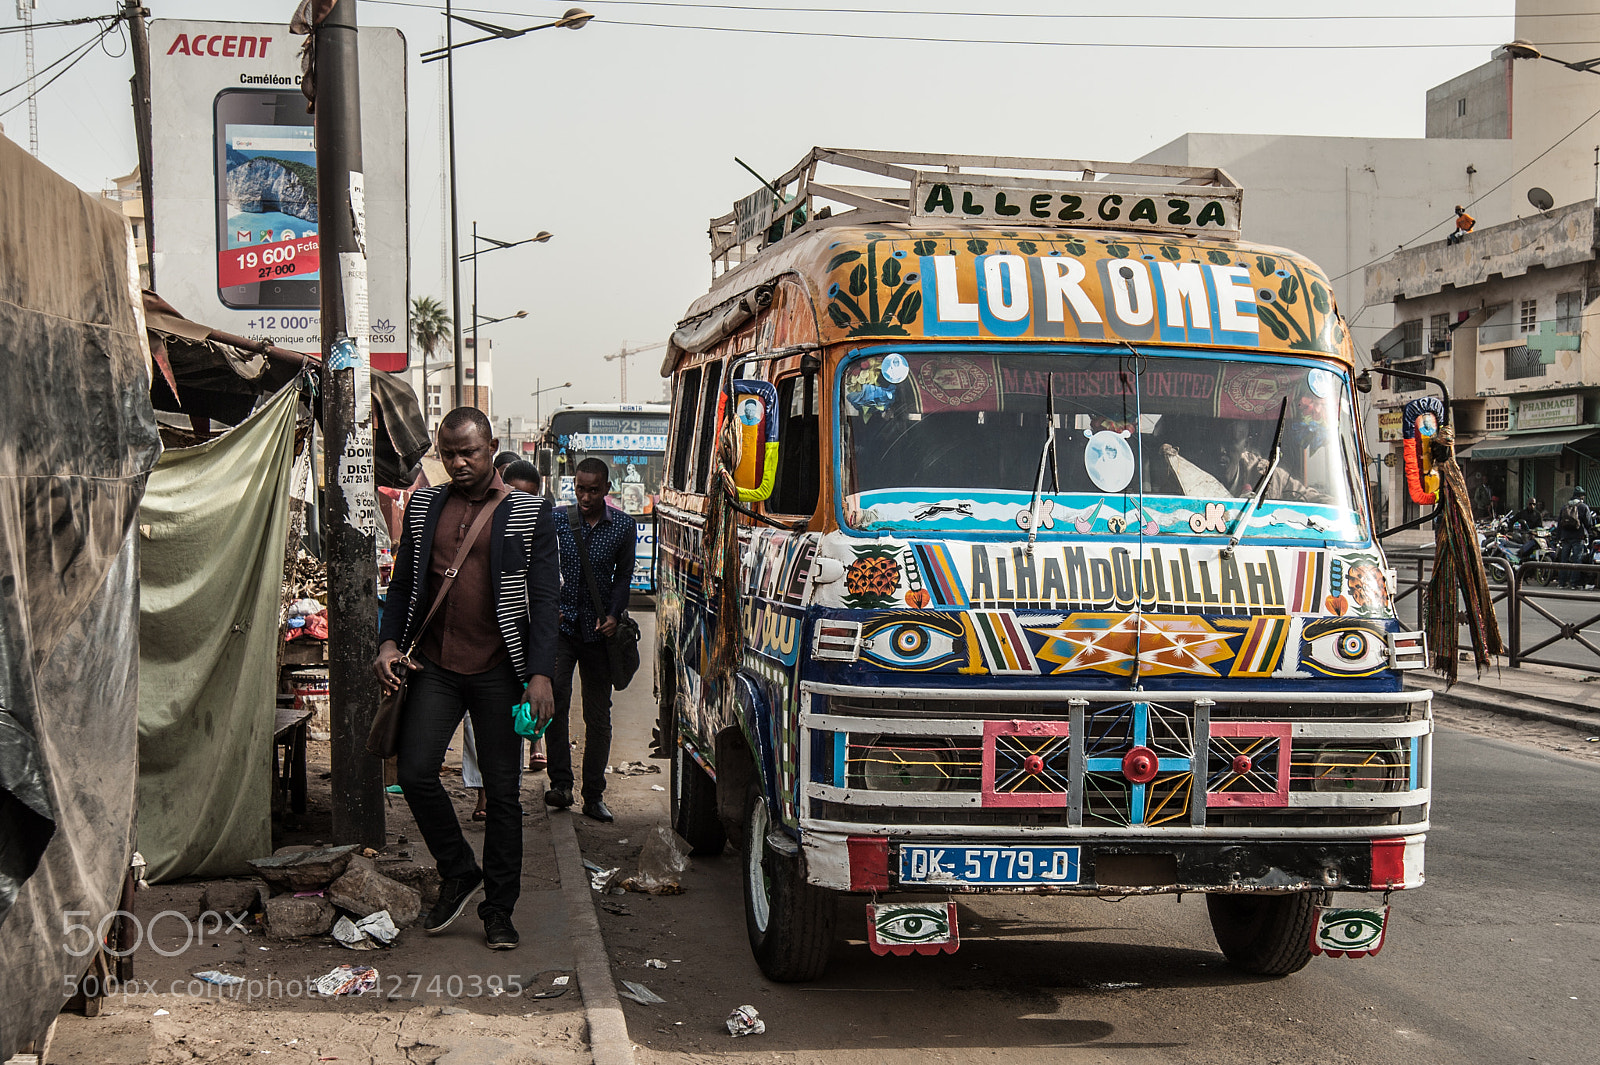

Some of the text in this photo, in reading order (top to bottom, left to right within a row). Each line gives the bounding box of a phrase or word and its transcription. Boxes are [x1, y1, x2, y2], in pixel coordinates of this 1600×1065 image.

[166, 33, 272, 58] ACCENT
[240, 73, 292, 85] Caméléon
[1097, 194, 1226, 227] GAZA
[237, 241, 319, 269] 19 600 Fcfa
[259, 263, 295, 278] 27 000
[928, 253, 1261, 337] LOROME
[248, 316, 276, 329] +12
[280, 316, 308, 329] 000
[1003, 368, 1137, 396] MANCHESTER
[1146, 371, 1215, 399] UNITED
[1522, 398, 1575, 412] PHARMACIE
[621, 420, 640, 433] 29
[584, 435, 614, 449] SANT
[342, 475, 354, 483] 247
[970, 545, 1286, 608] ALHAMDOULILLAHI
